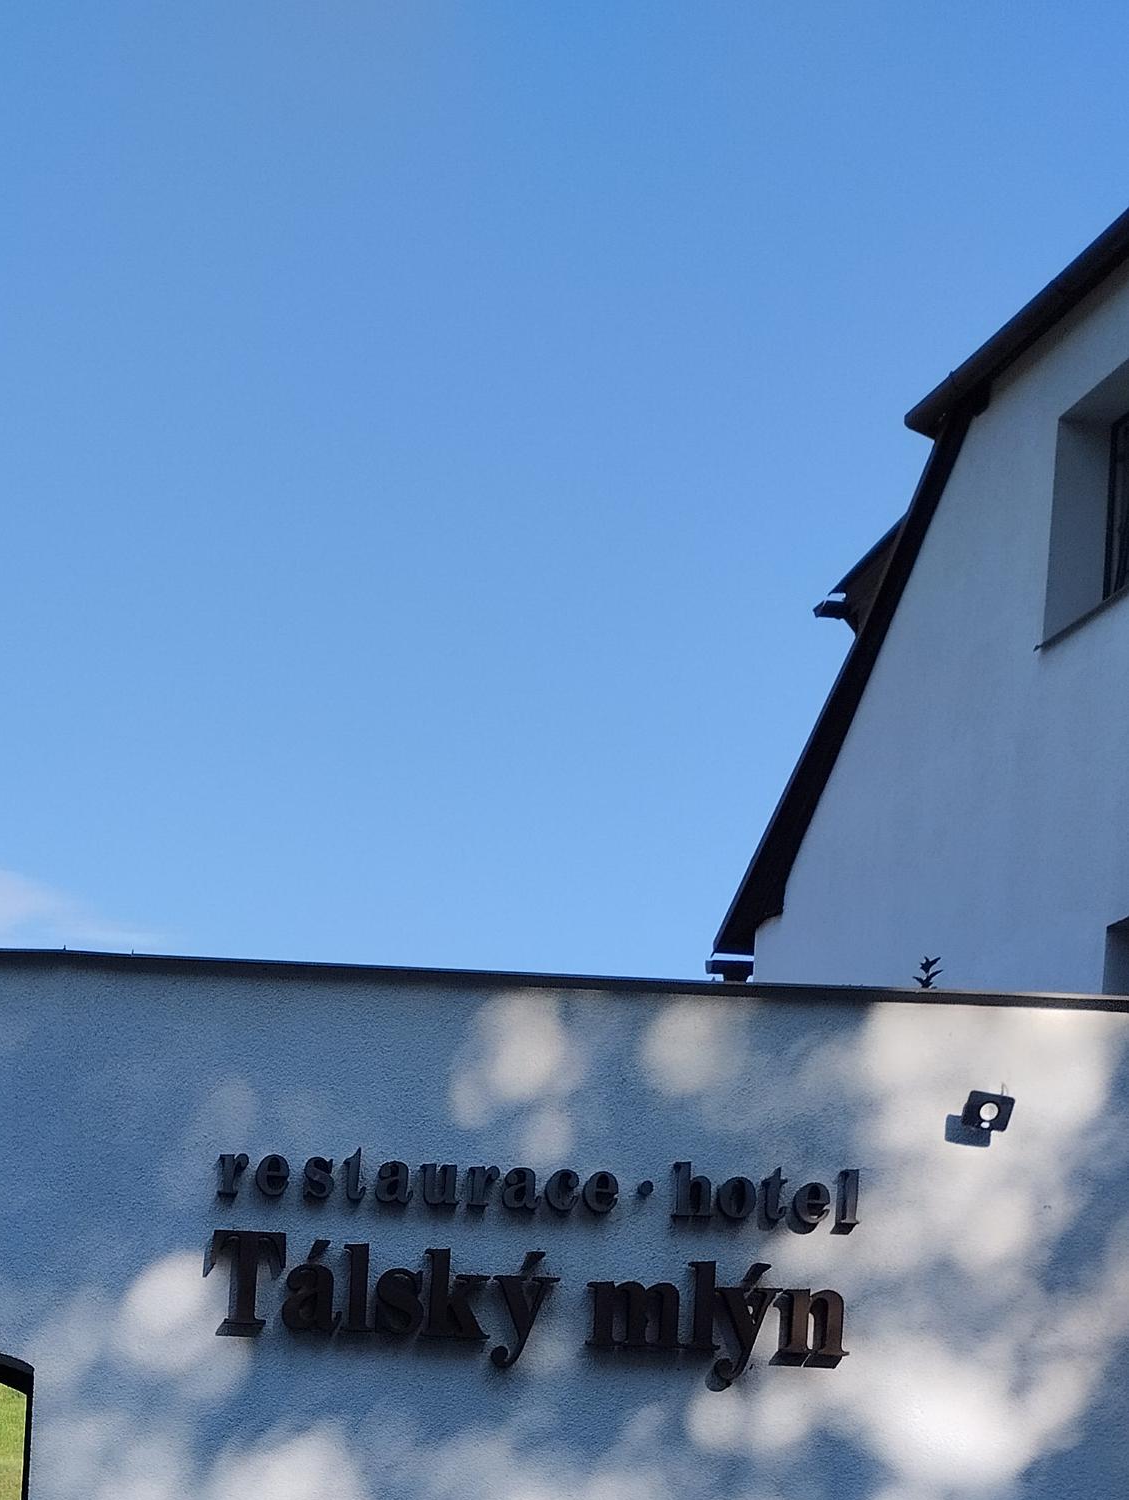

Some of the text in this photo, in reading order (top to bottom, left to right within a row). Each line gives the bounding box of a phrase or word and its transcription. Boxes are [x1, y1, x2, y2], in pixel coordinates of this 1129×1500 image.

[217, 1147, 861, 1235] restaurace hotel
[203, 1229, 851, 1386] Tálský mlýn
